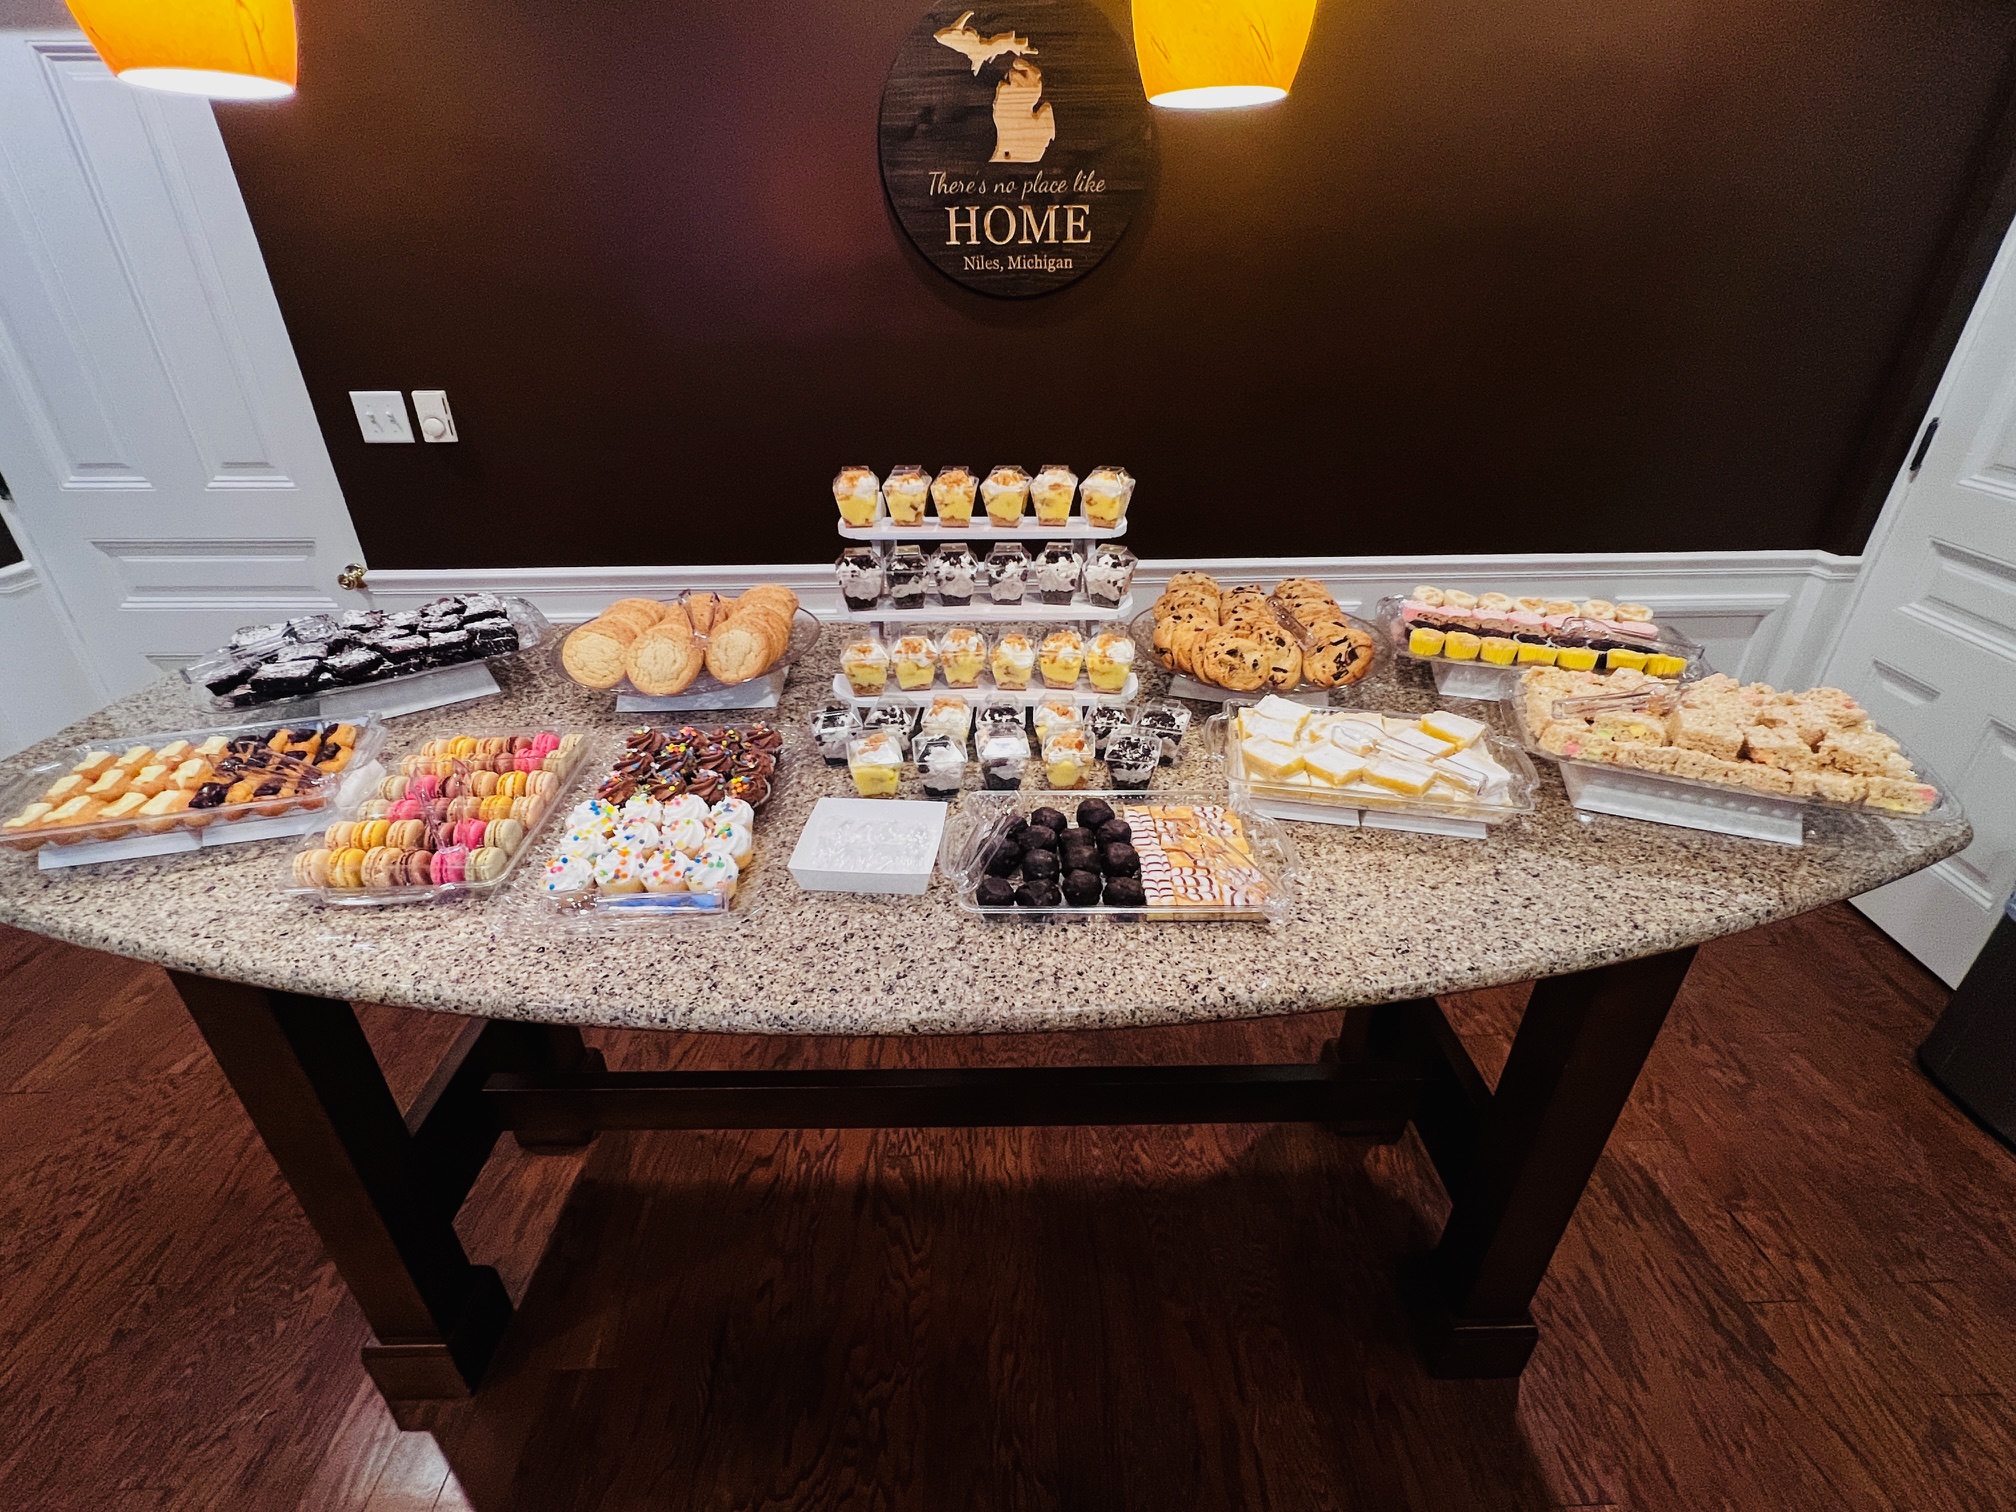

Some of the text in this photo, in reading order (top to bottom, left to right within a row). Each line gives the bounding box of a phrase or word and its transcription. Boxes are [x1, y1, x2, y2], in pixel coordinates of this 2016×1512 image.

[928, 169, 1107, 200] There's no place like
[944, 203, 1092, 246] HOME
[963, 253, 1073, 273] Niles, Michigan
